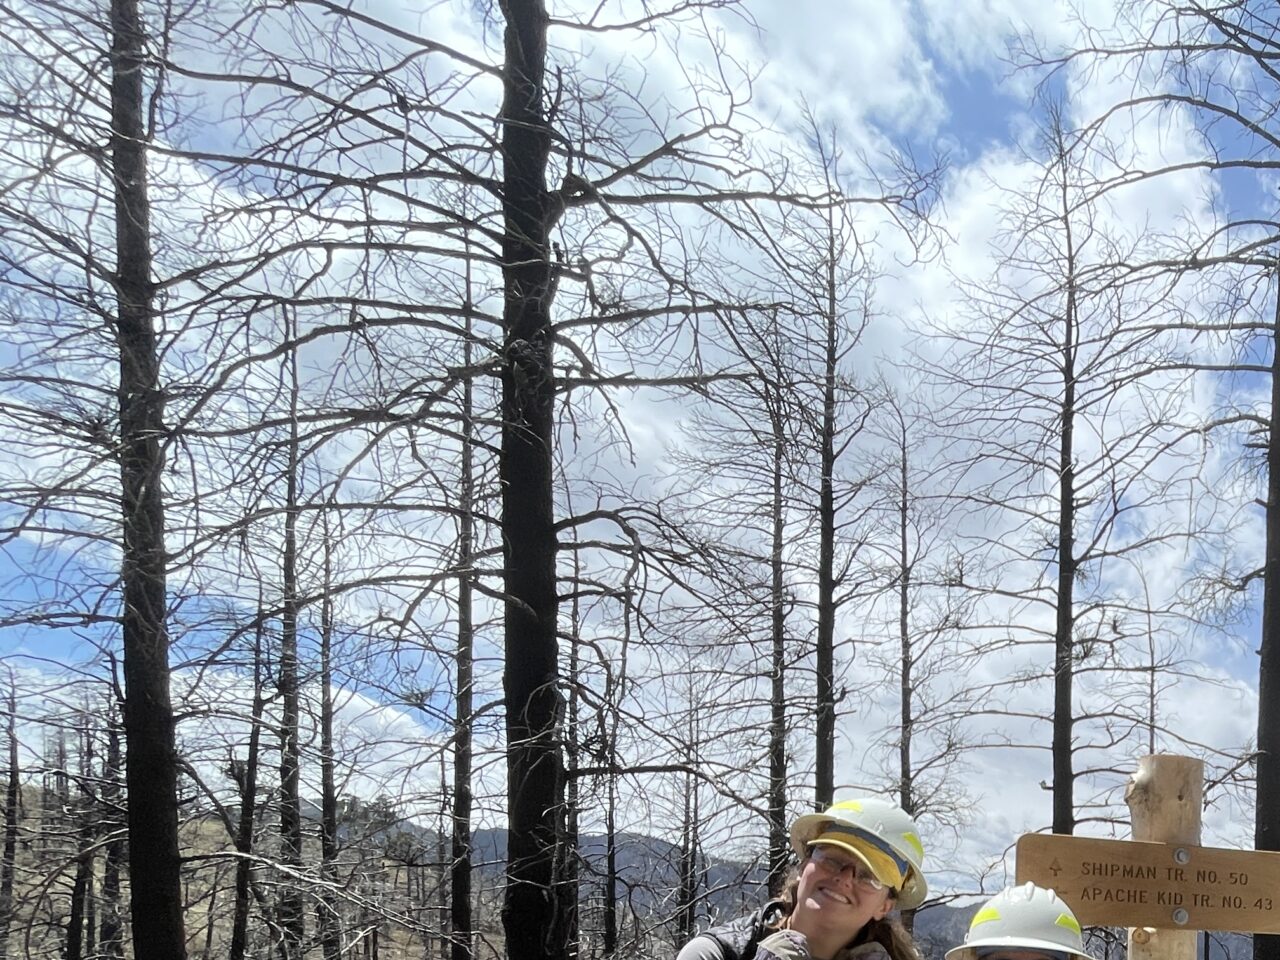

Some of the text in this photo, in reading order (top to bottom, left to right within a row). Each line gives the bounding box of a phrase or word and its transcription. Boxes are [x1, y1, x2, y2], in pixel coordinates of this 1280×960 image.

[1080, 861, 1249, 886] SHIPMAN TR. NO. 50
[1080, 886, 1273, 911] APACHE KID TR. NO. 43
